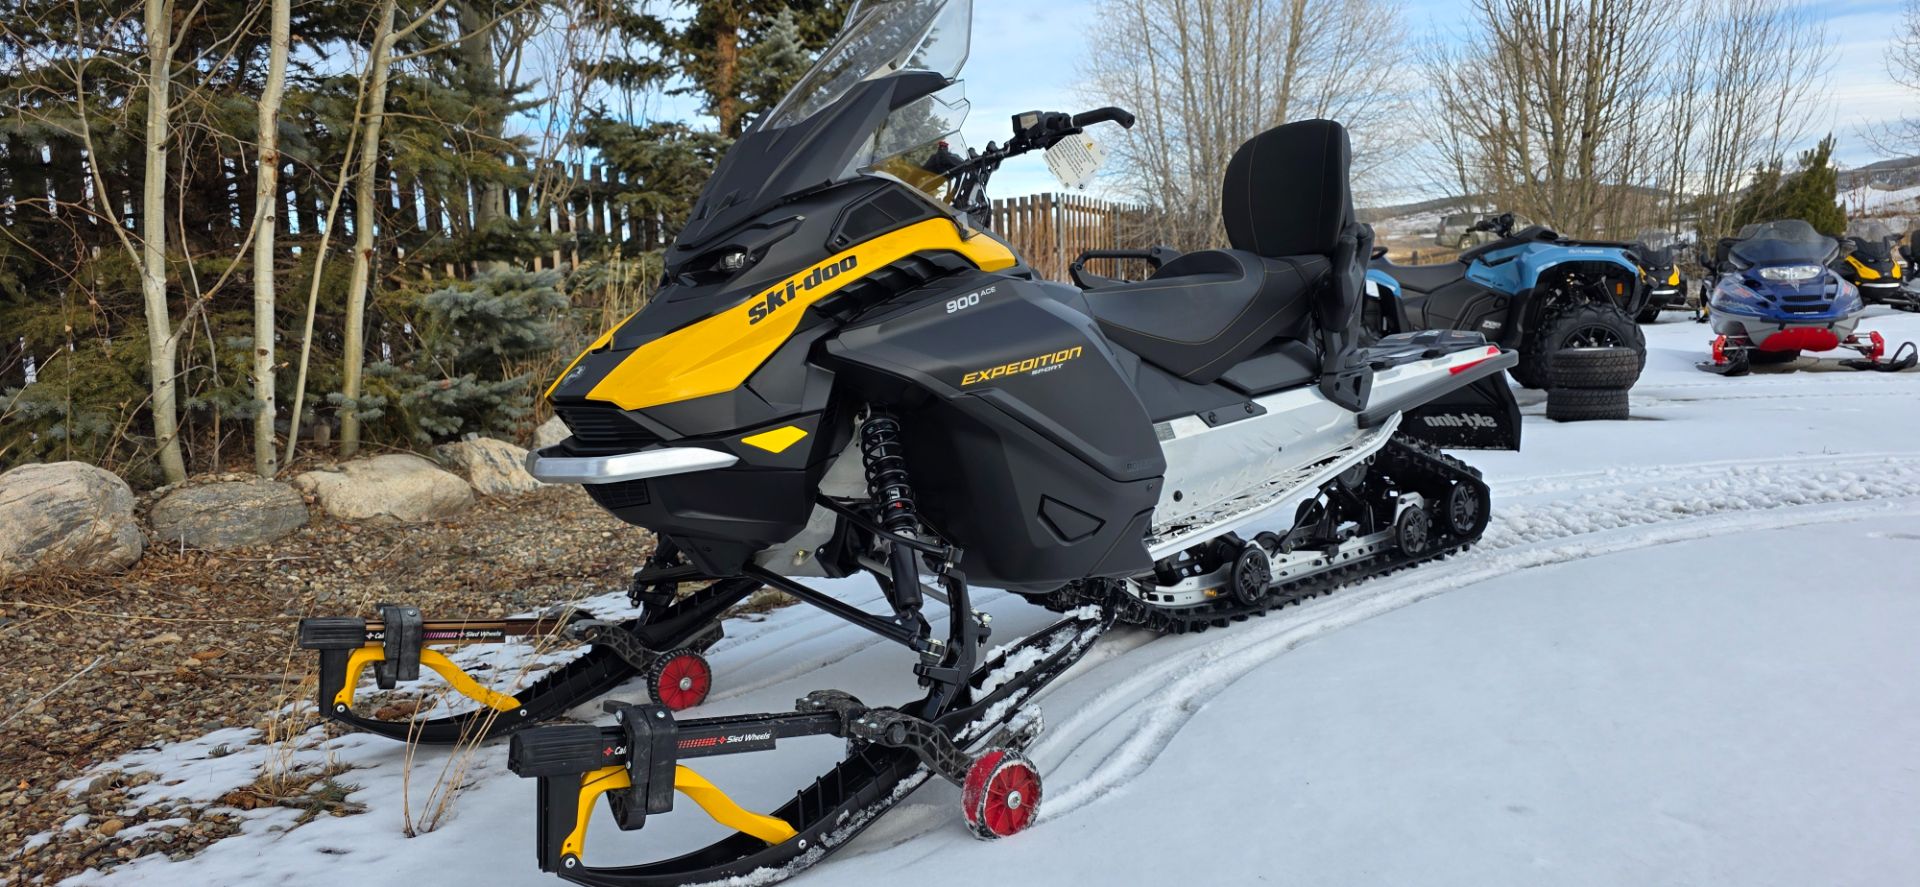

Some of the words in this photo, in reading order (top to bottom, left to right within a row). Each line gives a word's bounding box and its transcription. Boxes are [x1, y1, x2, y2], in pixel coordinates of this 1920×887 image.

[946, 292, 979, 313] 900
[980, 286, 996, 296] ACE
[961, 346, 1082, 386] EXPEDITION
[1031, 363, 1064, 376] SPORT
[726, 735, 743, 744] Sled
[744, 732, 771, 742] Wheels
[614, 745, 628, 756] Cal
